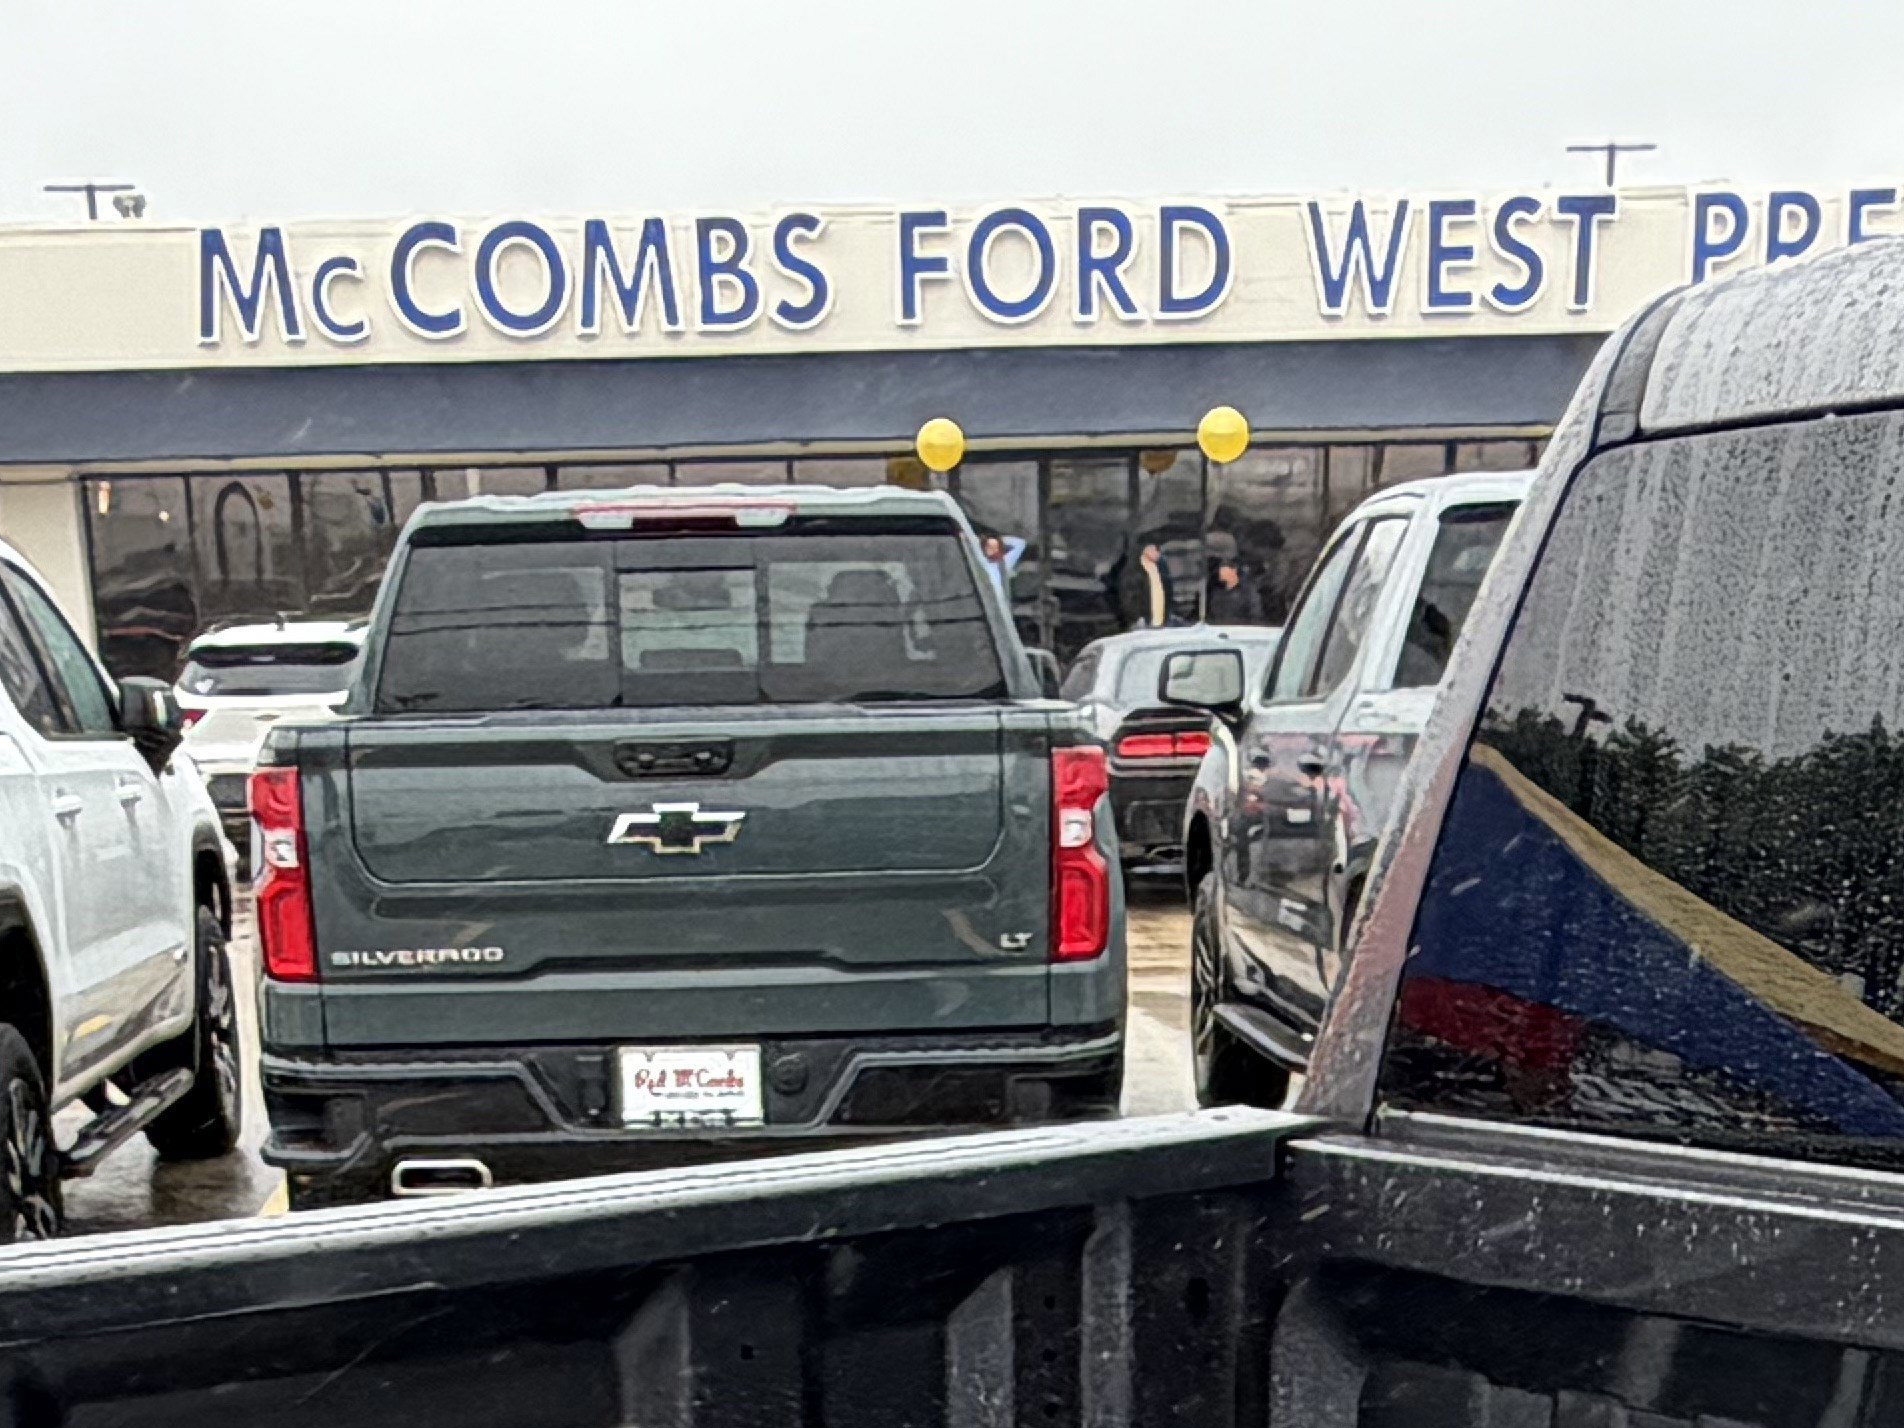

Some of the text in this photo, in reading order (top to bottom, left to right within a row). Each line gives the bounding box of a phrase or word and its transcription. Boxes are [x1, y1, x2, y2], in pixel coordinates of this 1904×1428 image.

[199, 213, 829, 341] McCOMBS
[899, 205, 1232, 320] FORD
[1307, 194, 1616, 308] WEST
[1000, 932, 1033, 948] LT
[330, 946, 504, 967] SILVERADO
